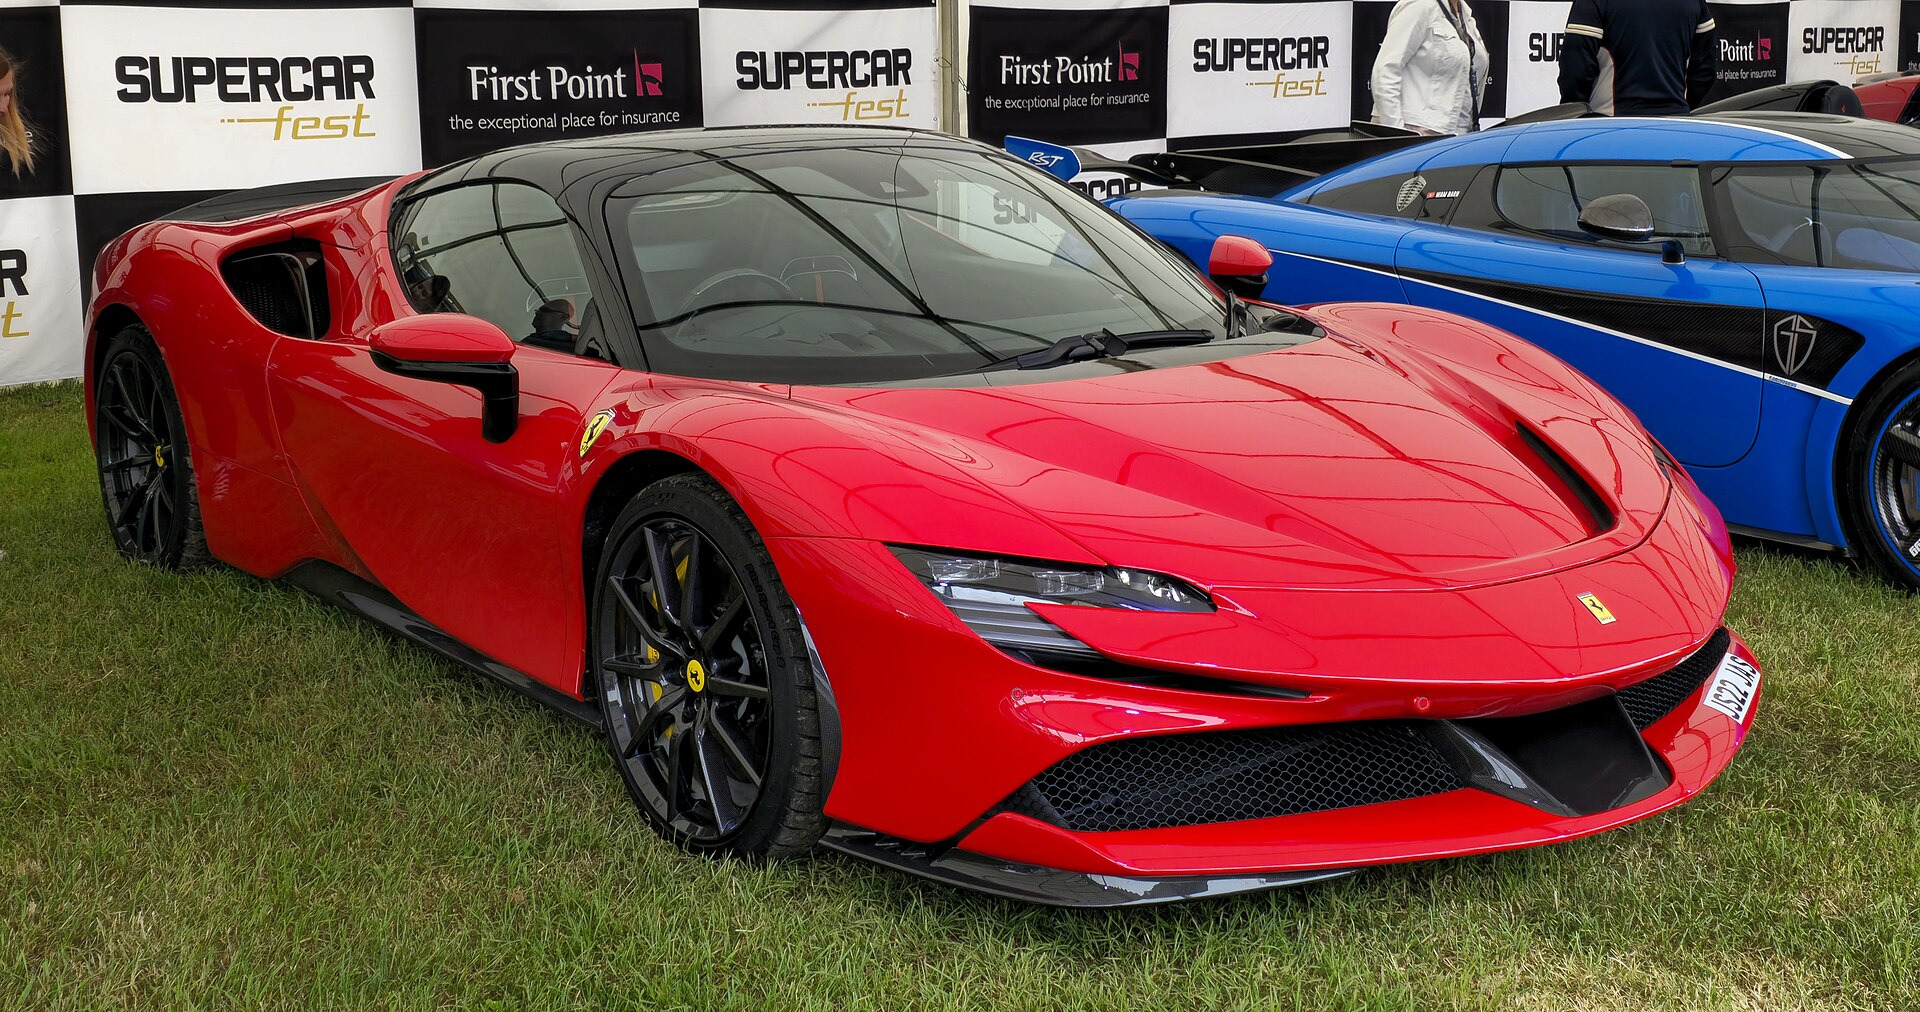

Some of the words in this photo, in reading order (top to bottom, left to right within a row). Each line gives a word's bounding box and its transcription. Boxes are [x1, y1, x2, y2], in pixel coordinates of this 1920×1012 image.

[1193, 36, 1329, 72] SUPERCAR
[1720, 38, 1754, 62] Point
[1803, 27, 1884, 53] SUPERCAR
[114, 55, 376, 103] SUPERCAR
[736, 48, 912, 90] SUPERCAR
[999, 55, 1051, 85] First
[1056, 55, 1113, 83] Point
[1725, 69, 1739, 81] place
[1740, 69, 1749, 79] for
[1750, 68, 1776, 78] insurance
[1840, 54, 1882, 75] fest
[466, 65, 541, 101] First
[545, 64, 628, 100] Point
[1256, 71, 1327, 98] fest
[817, 90, 909, 121] fest
[985, 95, 1002, 109] the
[1004, 94, 1060, 112] exceptional
[1063, 94, 1087, 111] place
[1090, 92, 1104, 106] for
[1106, 91, 1150, 105] insurance
[237, 103, 376, 141] fest
[449, 114, 473, 130] the
[478, 112, 557, 133] exceptional
[562, 112, 596, 131] place
[598, 110, 618, 126] for
[622, 109, 680, 125] insurance
[1028, 151, 1065, 168] RST
[1724, 655, 1757, 687] JAS
[1710, 679, 1749, 720] JS22
